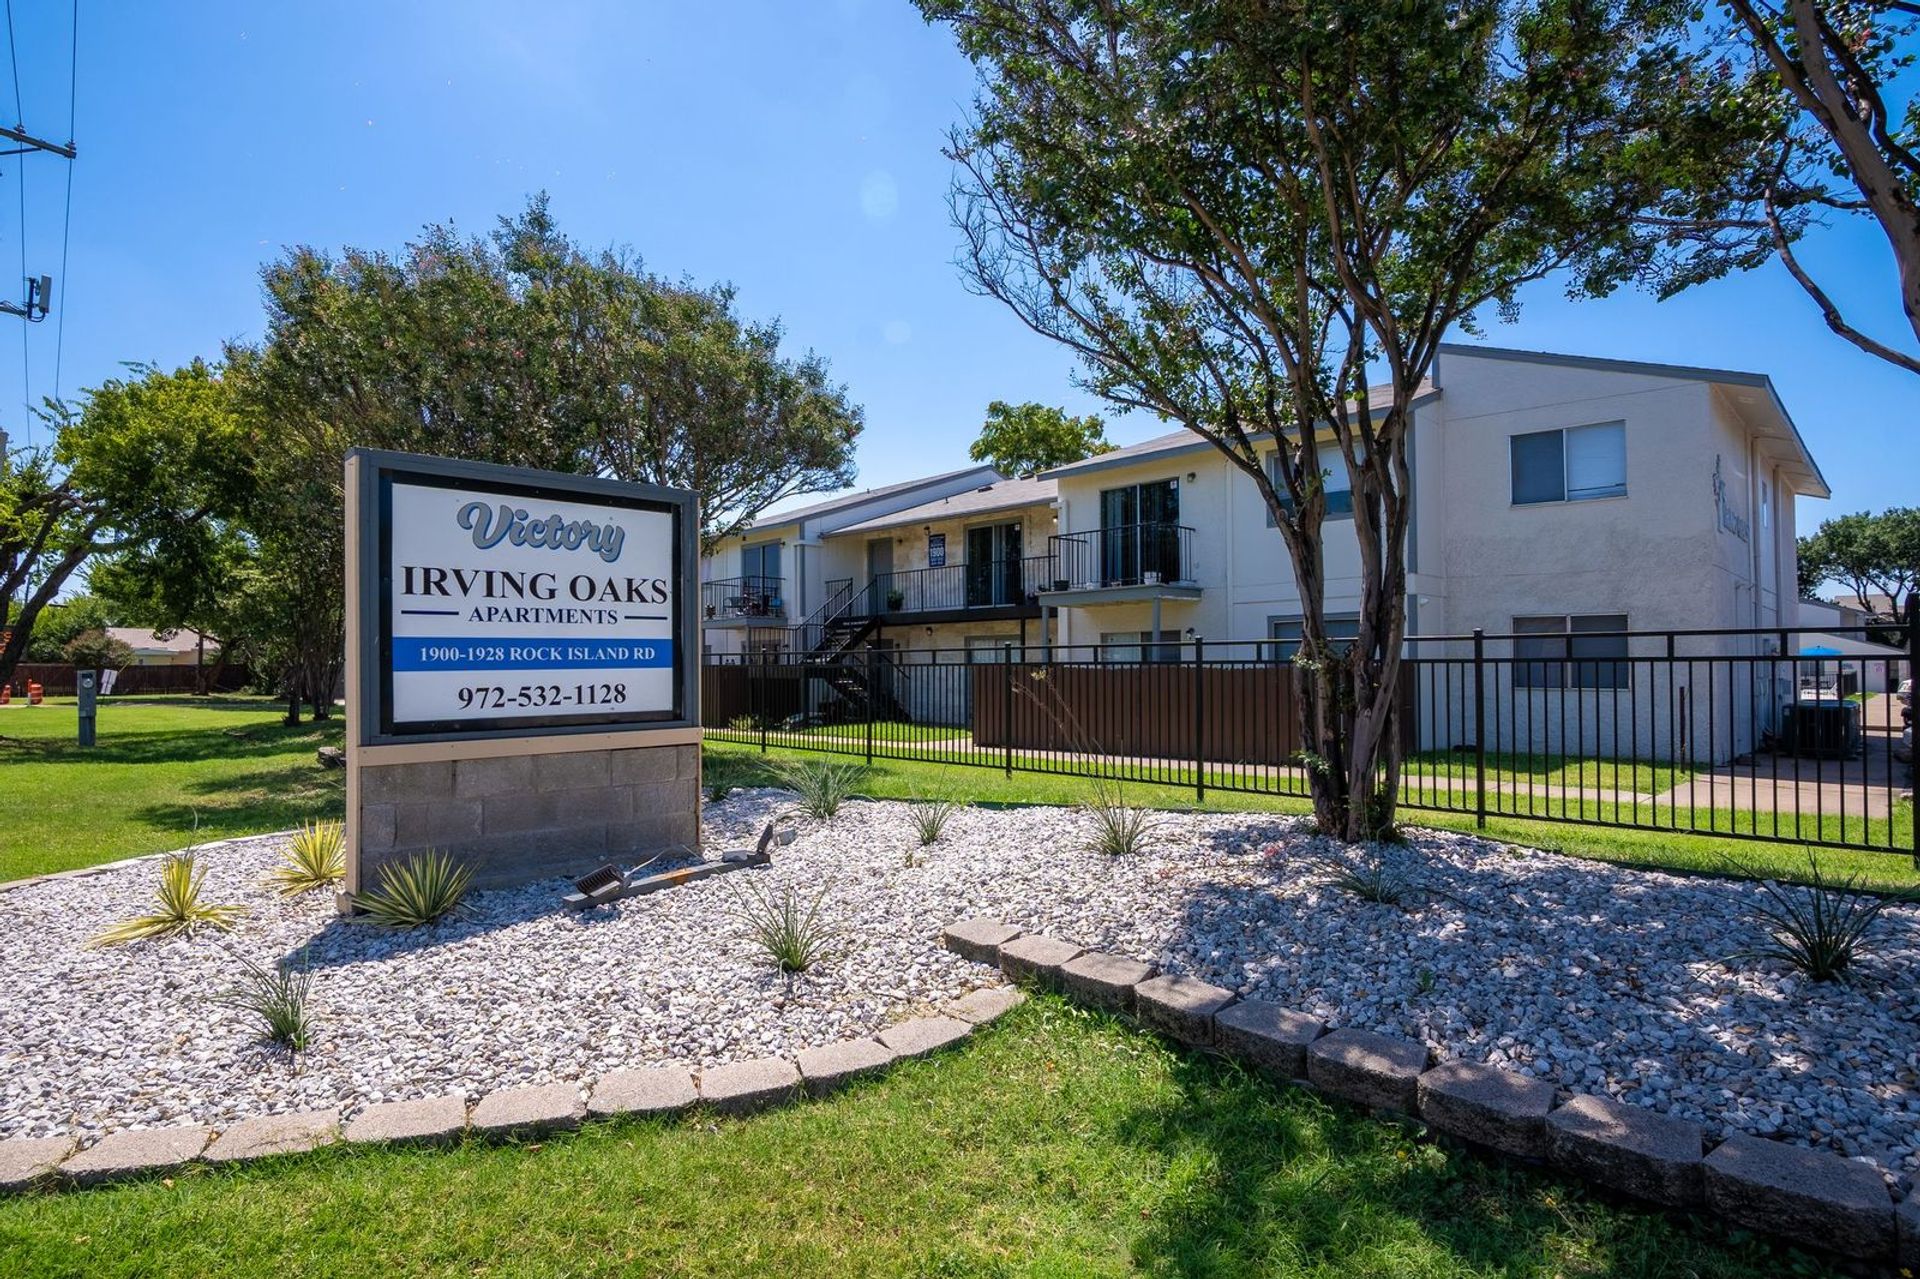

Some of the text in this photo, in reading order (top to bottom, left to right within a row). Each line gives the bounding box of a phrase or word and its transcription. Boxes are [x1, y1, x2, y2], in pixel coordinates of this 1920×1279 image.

[457, 501, 625, 563] Victory
[400, 566, 668, 604] IRVING OAKS
[469, 607, 618, 624] APARTMENTS
[420, 647, 655, 663] 1900-1928 ROCK ISLAND RD
[458, 683, 626, 710] 972-532-1128
